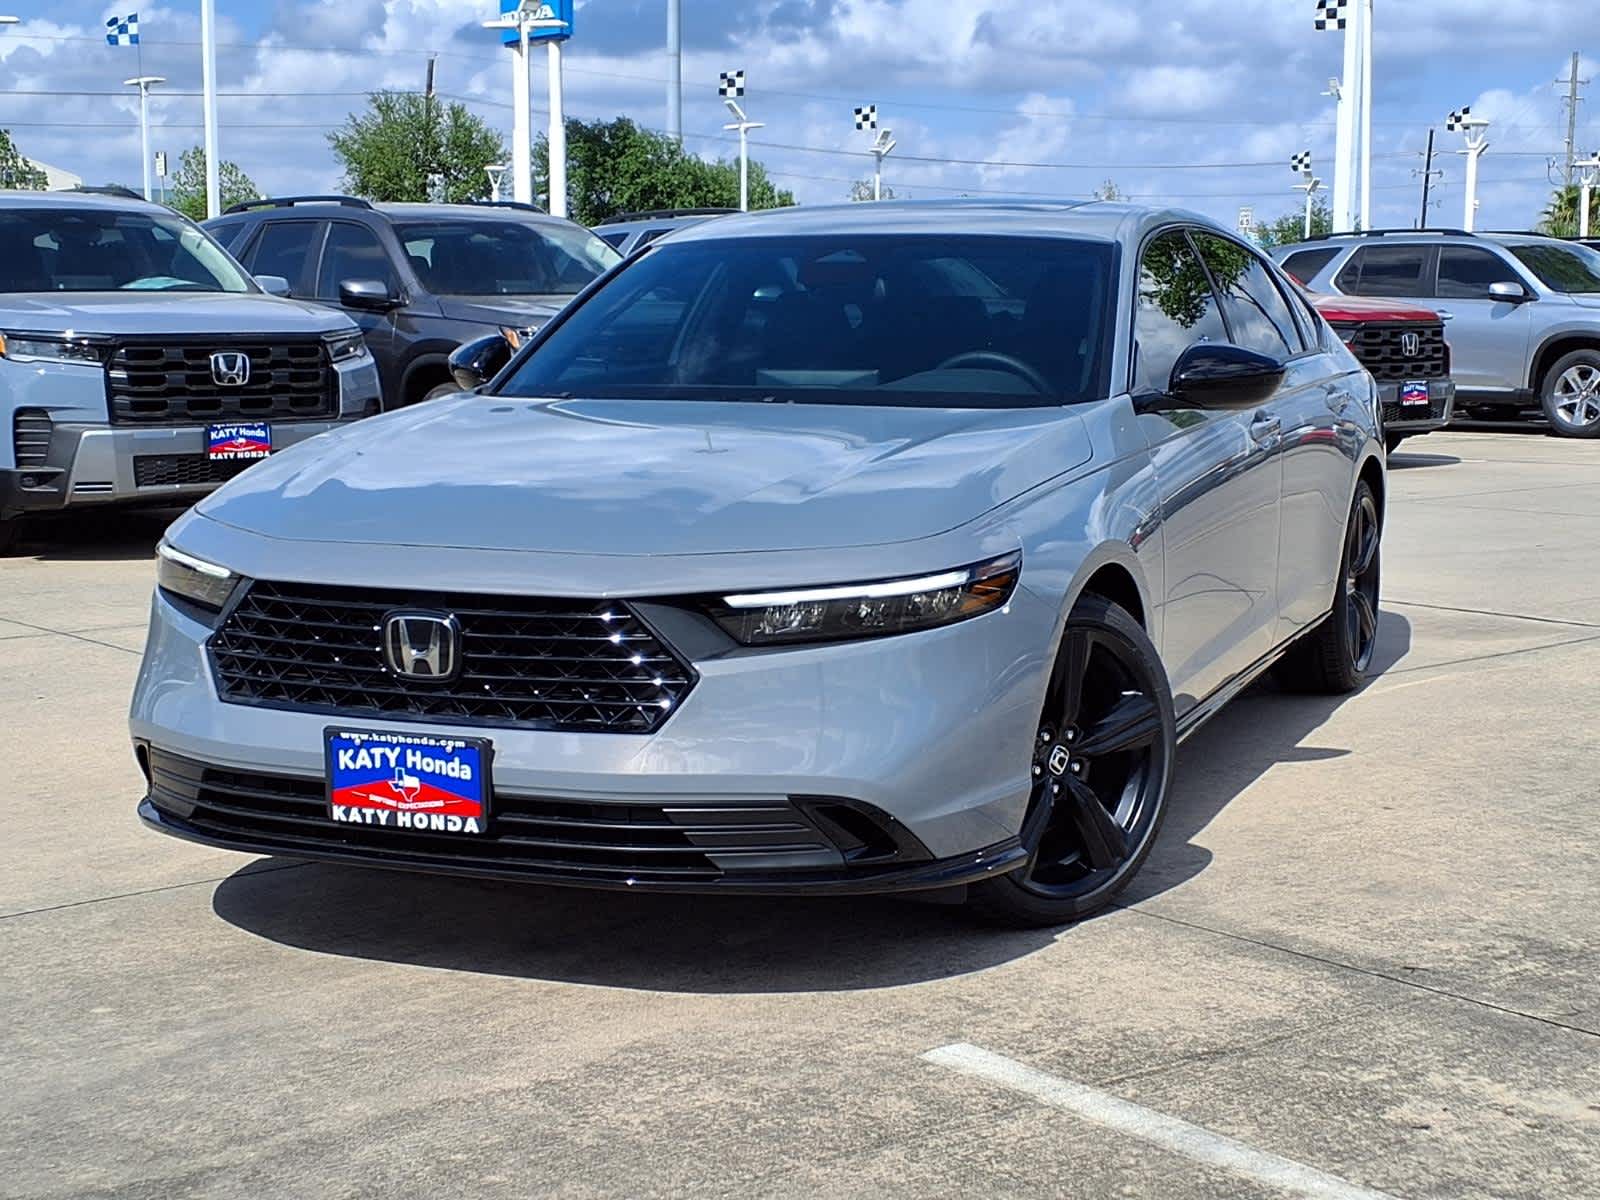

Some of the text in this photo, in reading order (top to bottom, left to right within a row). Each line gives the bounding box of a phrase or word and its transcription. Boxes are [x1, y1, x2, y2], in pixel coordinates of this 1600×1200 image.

[210, 427, 266, 440] KATY Honda
[209, 451, 270, 460] KATY HONDA
[340, 731, 466, 749] www.katyhonda.com
[338, 747, 472, 780] KATY Honda
[332, 805, 390, 826] KATY
[397, 811, 480, 834] HONDA
